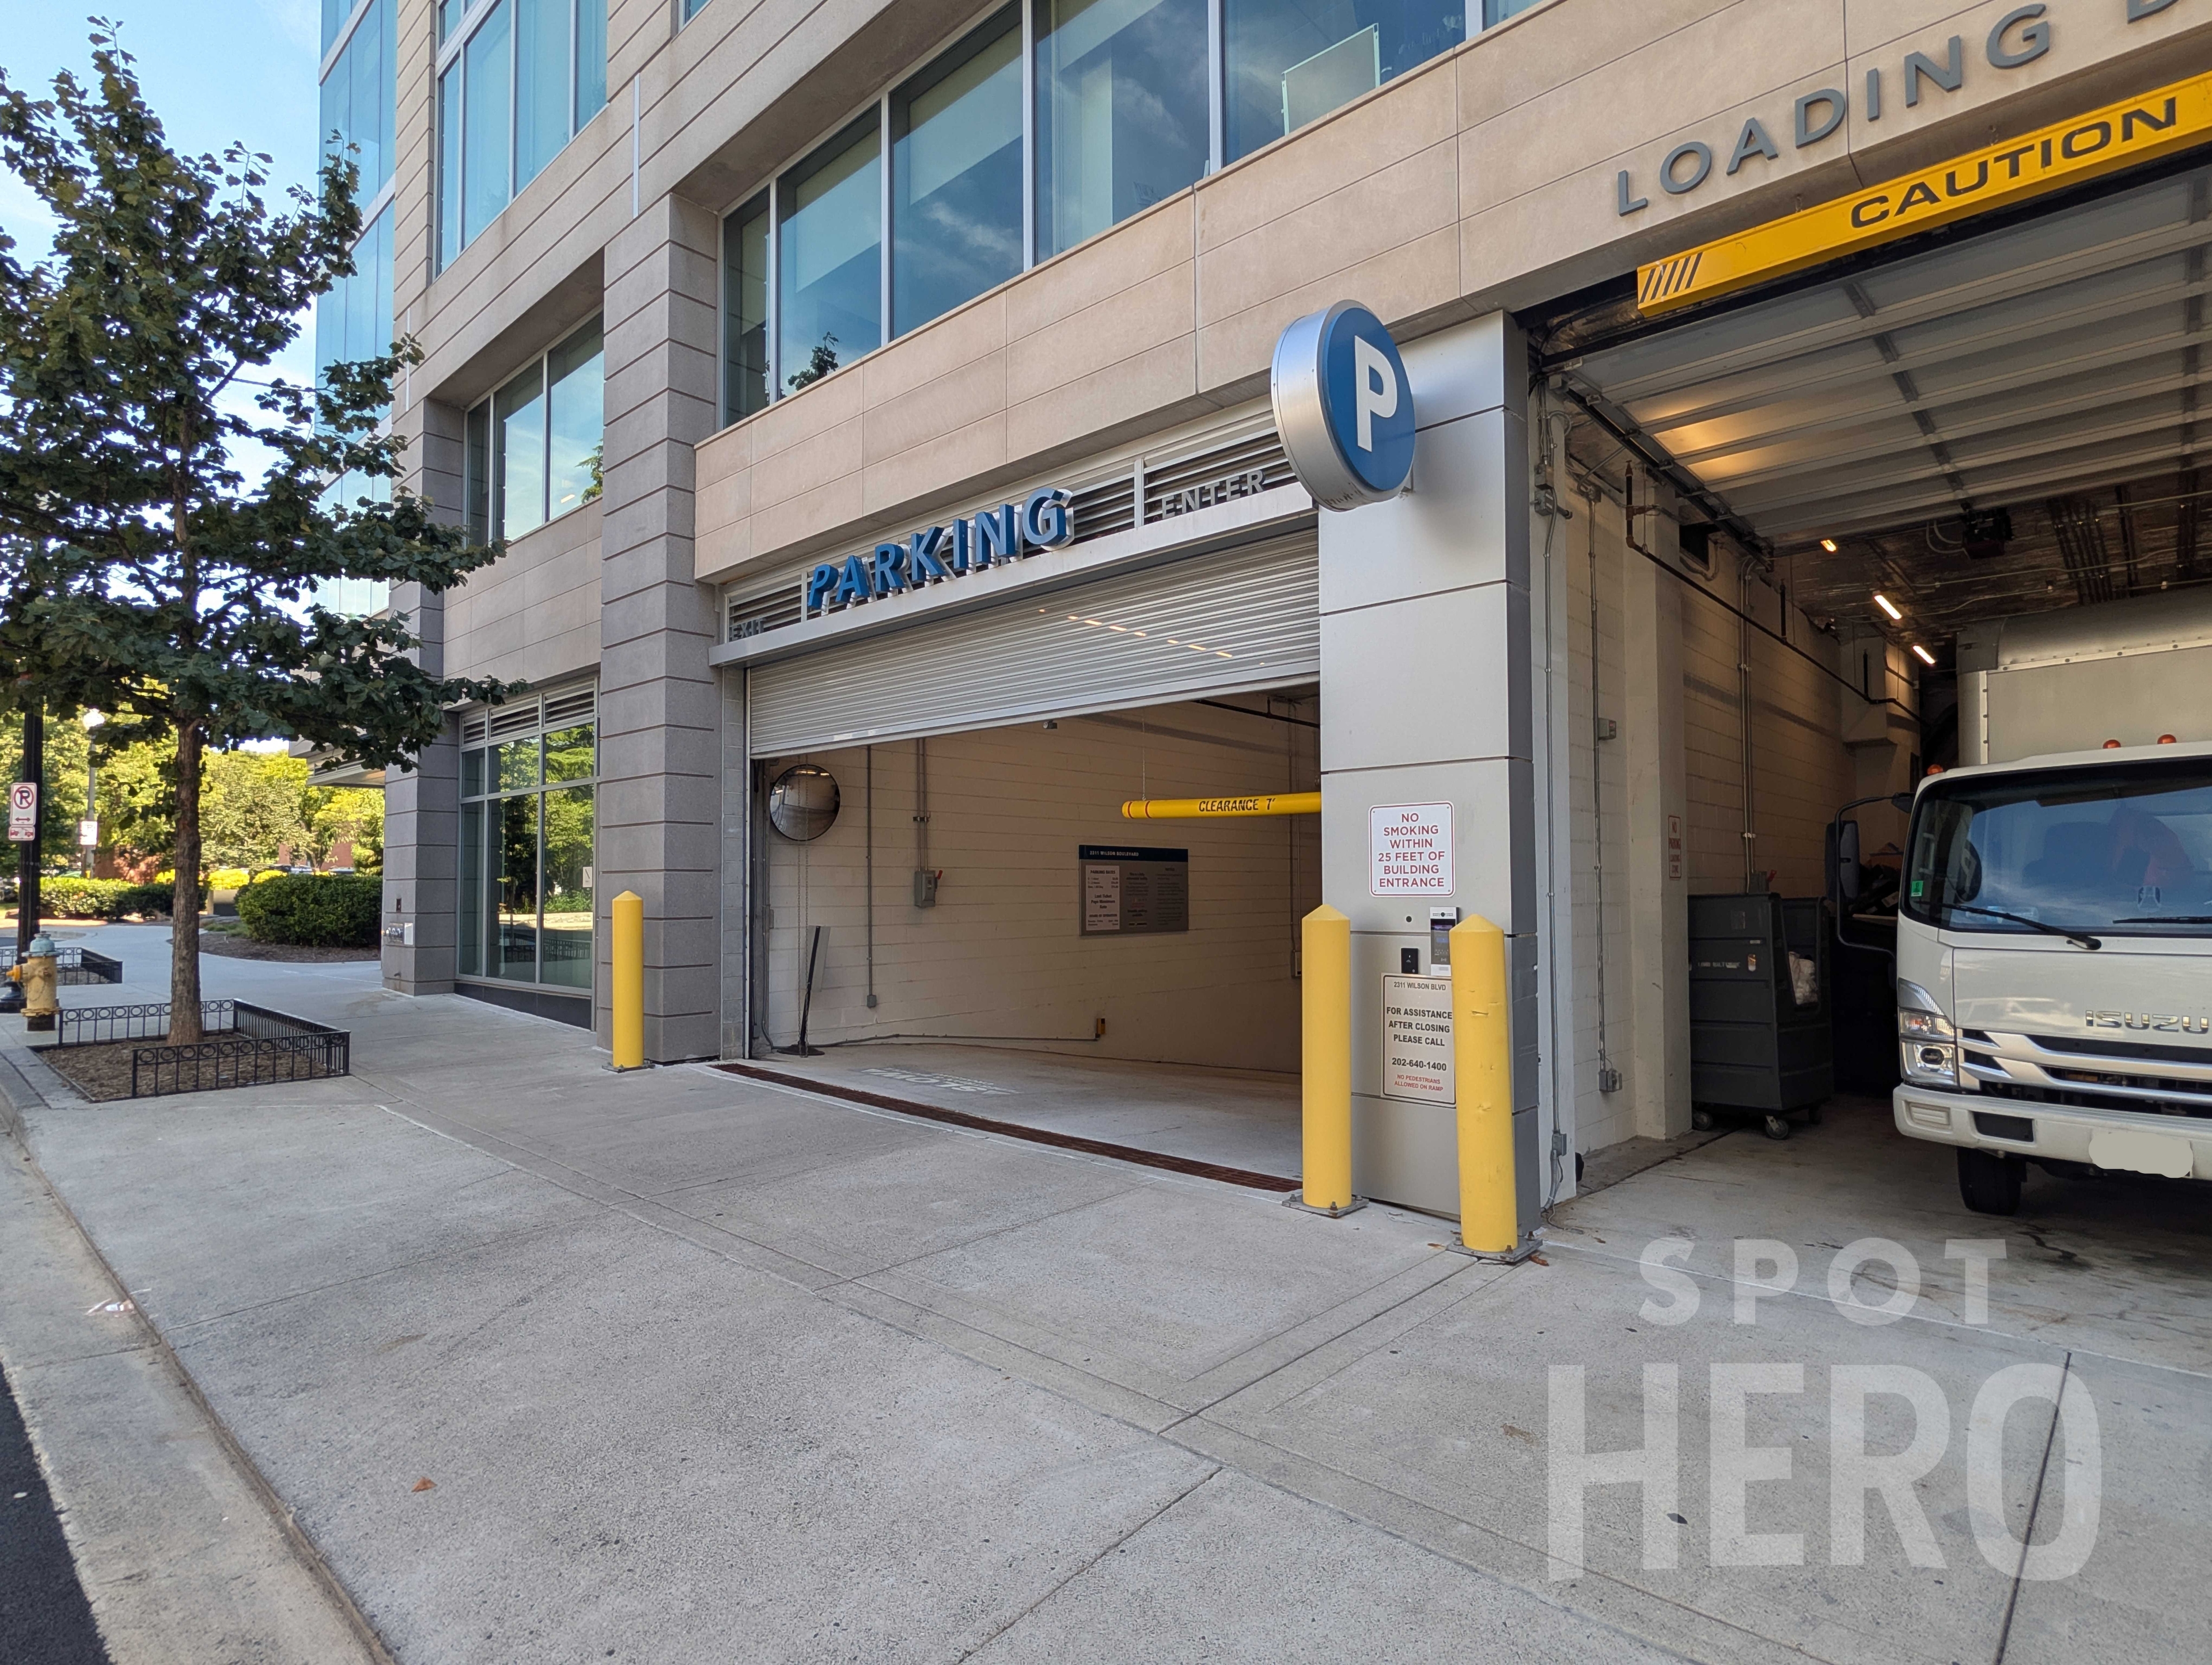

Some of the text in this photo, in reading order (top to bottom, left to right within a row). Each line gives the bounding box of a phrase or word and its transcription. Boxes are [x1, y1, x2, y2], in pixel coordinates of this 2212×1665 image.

[1617, 3, 2050, 218] LOADING
[1851, 97, 2177, 229] CAUTION
[1354, 335, 1397, 452] P
[1162, 469, 1266, 519] ENTER
[808, 487, 1074, 615] PARKING
[1199, 799, 1259, 811] CLEARANCE
[1402, 813, 1419, 822] NO
[1384, 825, 1438, 836] SMOKING
[1389, 838, 1433, 849] WITHIN
[1378, 851, 1445, 862] 25 FEET OF
[1384, 864, 1439, 875] BUILDING
[1379, 877, 1444, 887] ENTRANCE
[1387, 1007, 1452, 1019] FOR ASSISTANCE
[1388, 1020, 1450, 1033] AFTER CLOSING
[2085, 1010, 2209, 1034] ISUZU
[1393, 1034, 1445, 1046] PLEASE CALL
[1392, 1057, 1447, 1071] 202-640-1400
[1394, 1080, 1419, 1088] ALLOWED
[1406, 1075, 1440, 1084] PEDESTRIANS
